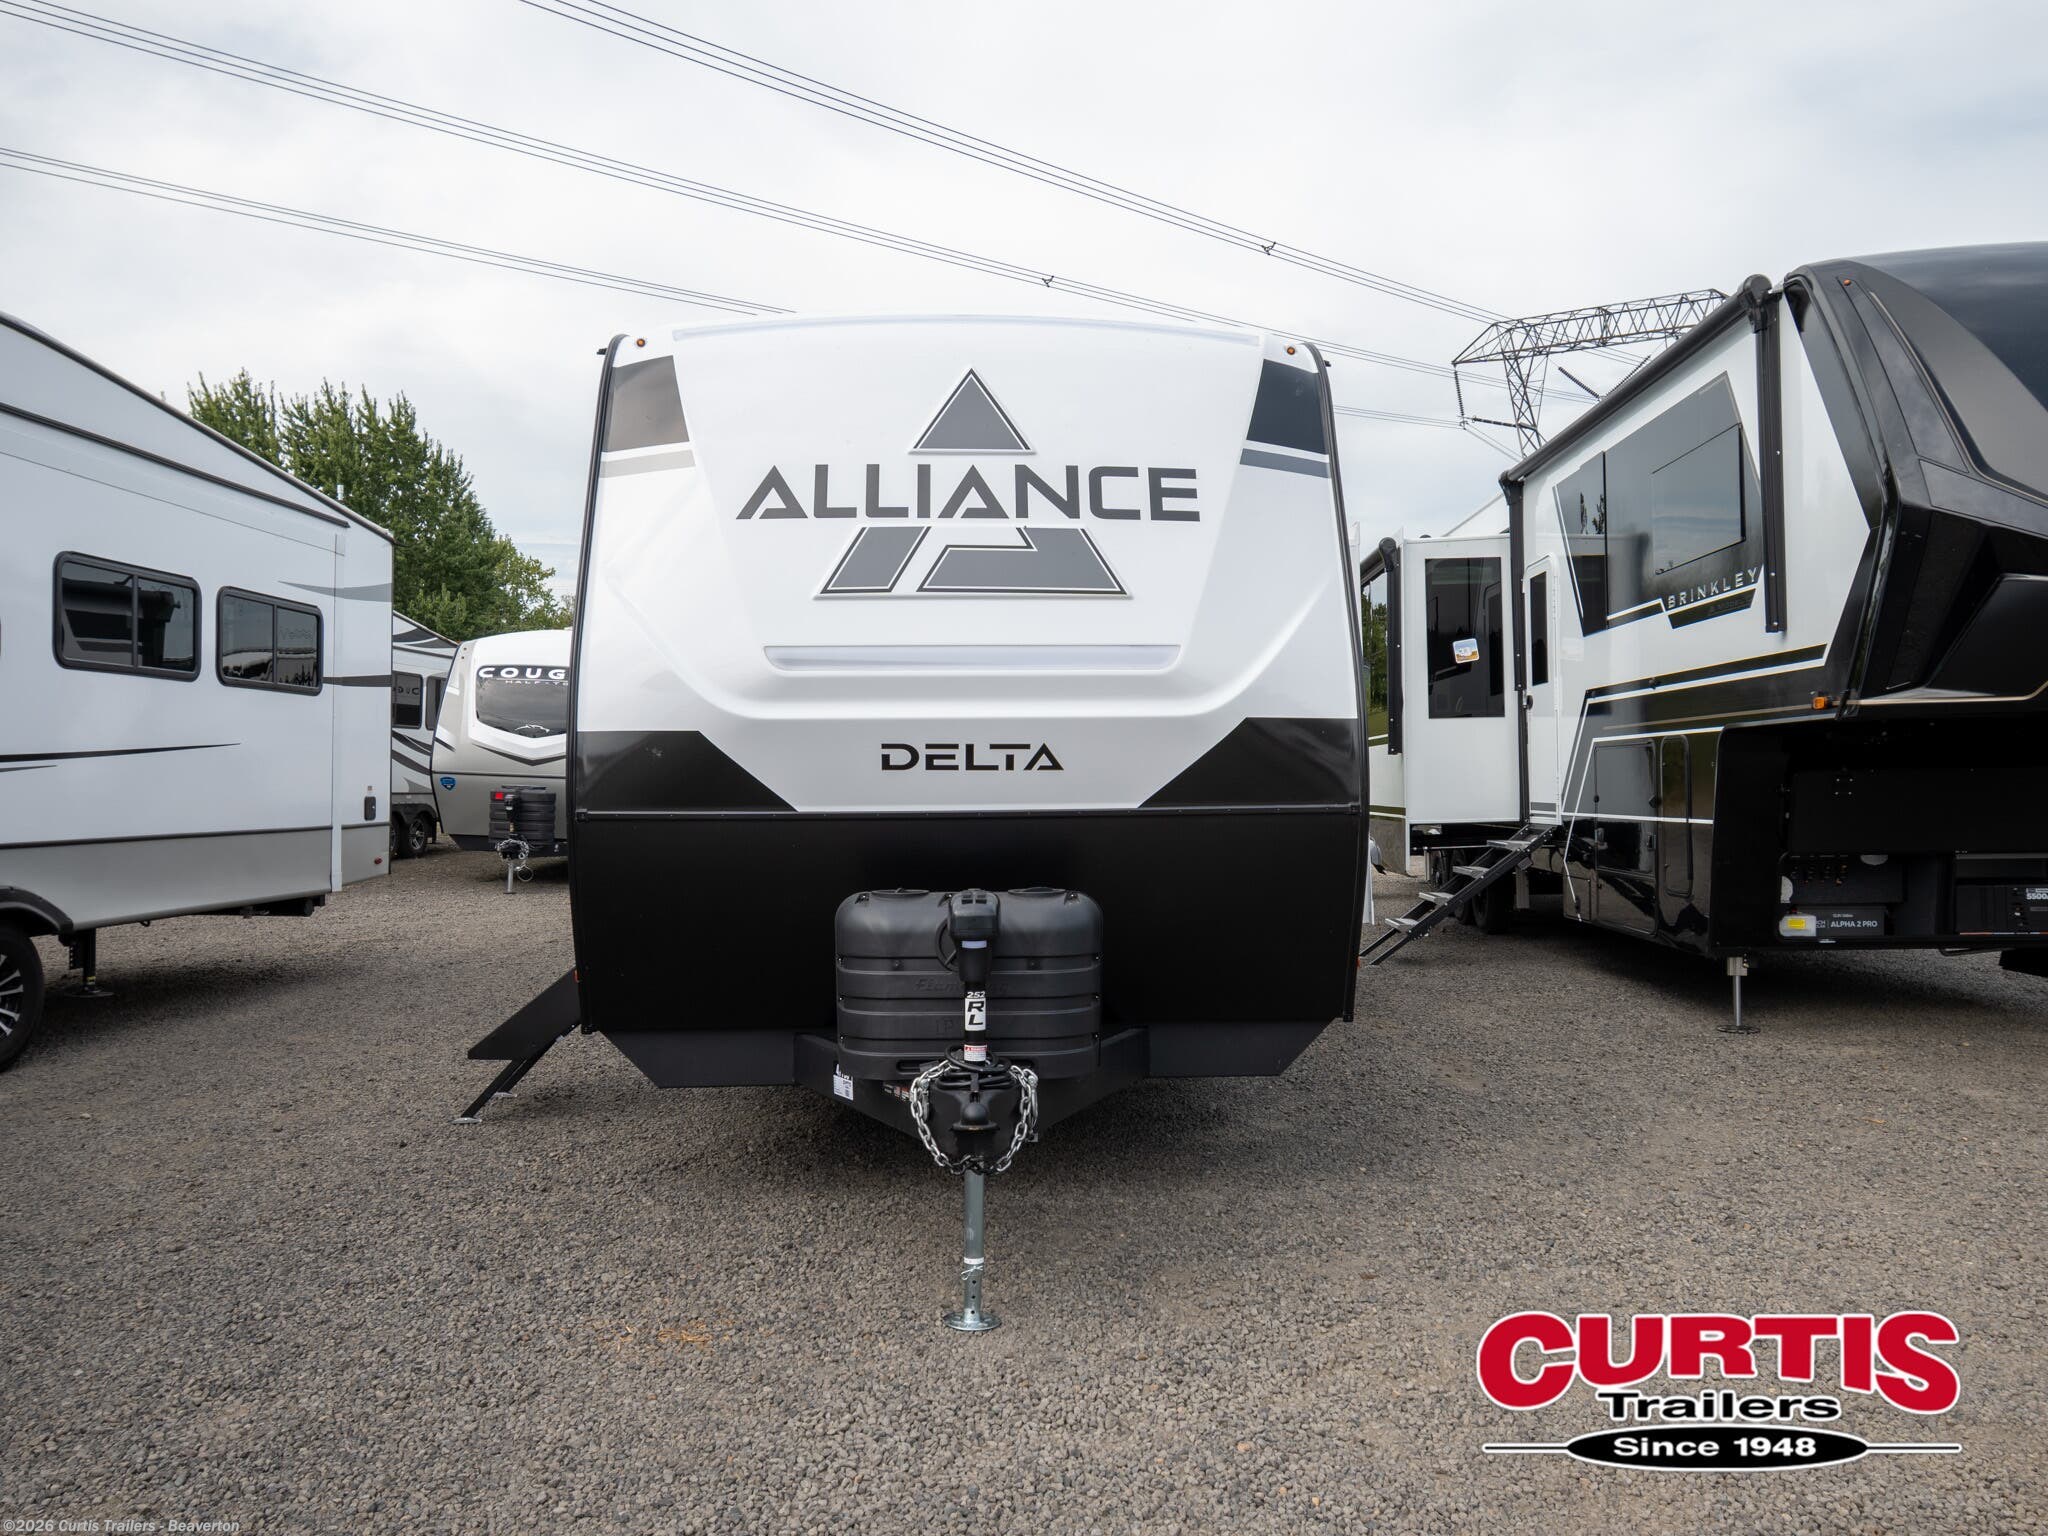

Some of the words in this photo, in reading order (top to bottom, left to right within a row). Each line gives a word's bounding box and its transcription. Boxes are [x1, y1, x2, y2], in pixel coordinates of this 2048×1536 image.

[736, 463, 1200, 522] ALLIANCE
[1667, 567, 1758, 609] BRINKLEY
[478, 667, 566, 680] COUG
[881, 742, 1065, 771] DELTA
[1830, 920, 1855, 928] ALPHA
[1856, 920, 1862, 928] 2
[1862, 920, 1878, 928] PRO
[967, 990, 986, 998] 252
